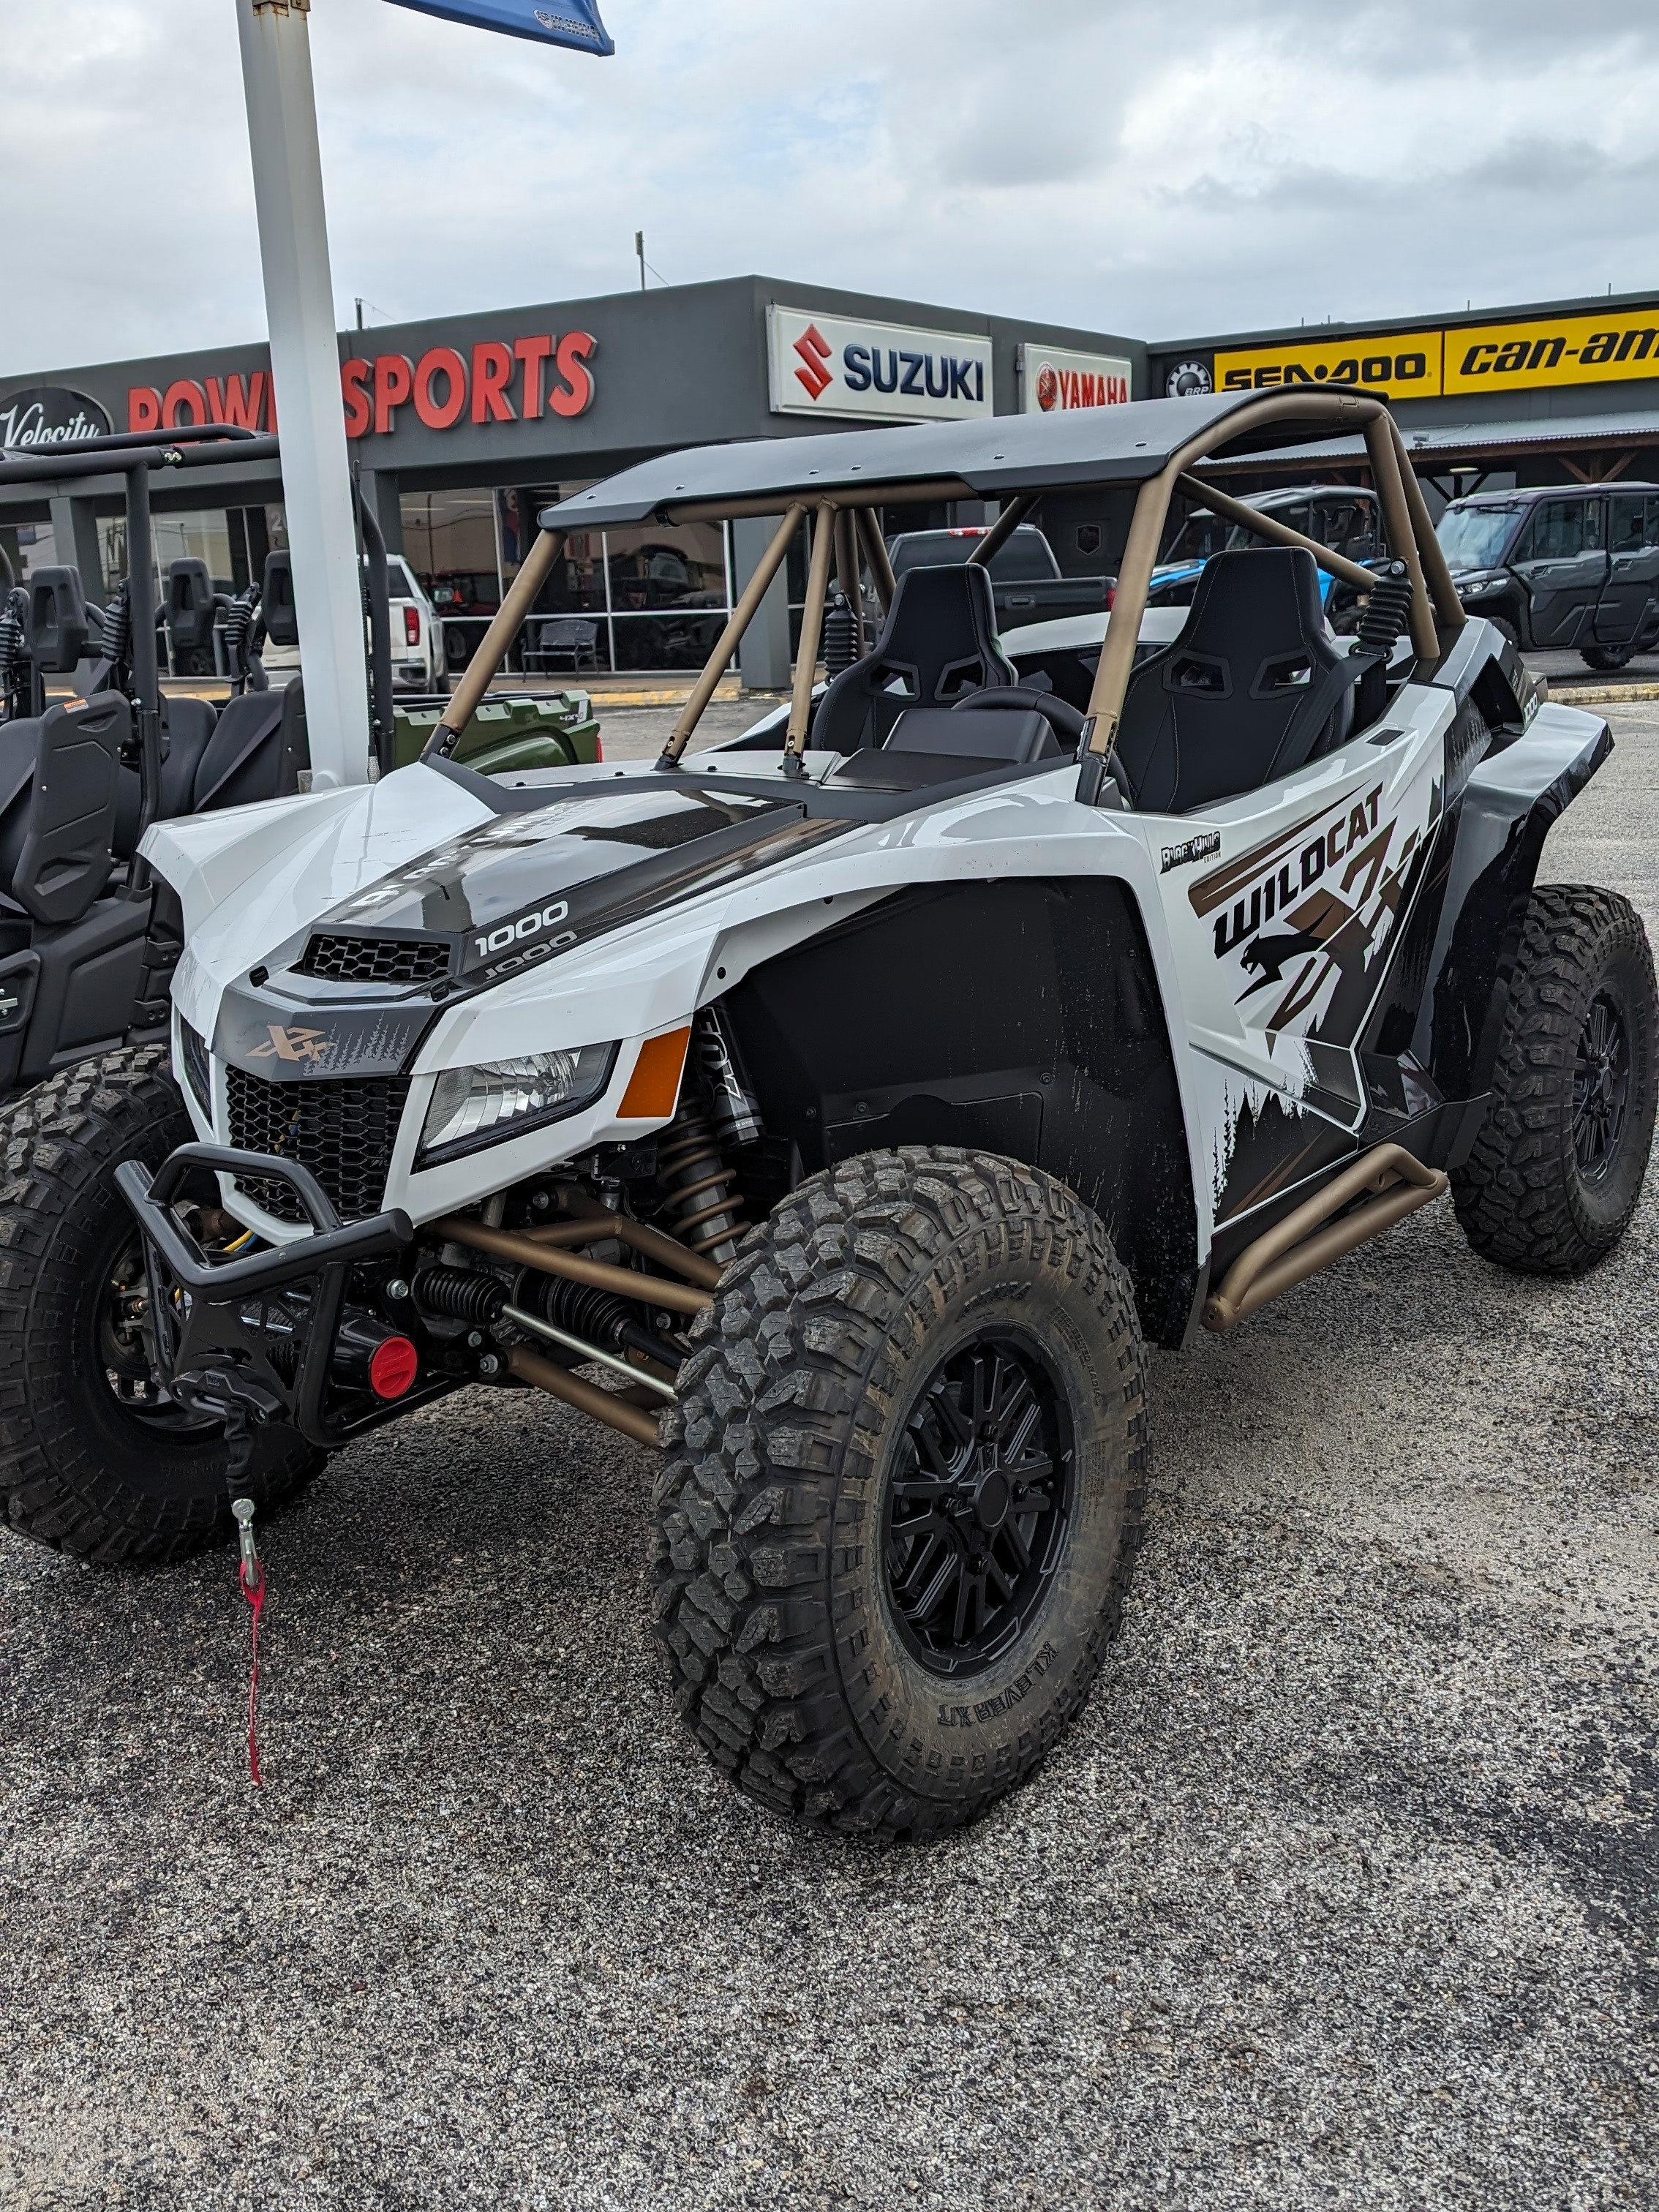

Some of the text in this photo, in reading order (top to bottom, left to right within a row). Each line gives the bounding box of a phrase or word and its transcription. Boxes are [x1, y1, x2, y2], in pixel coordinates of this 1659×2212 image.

[843, 344, 984, 402] SUZUKI
[1058, 369, 1128, 410] YAMAHA
[1184, 386, 1209, 396] BRP
[1203, 851, 1221, 863] EDITION
[1213, 781, 1383, 959] WILDCAT
[475, 900, 568, 957] 1000
[696, 1004, 742, 1099] FOX
[1072, 1328, 1091, 1361] BELTED
[973, 1640, 1060, 1723] KLEVER
